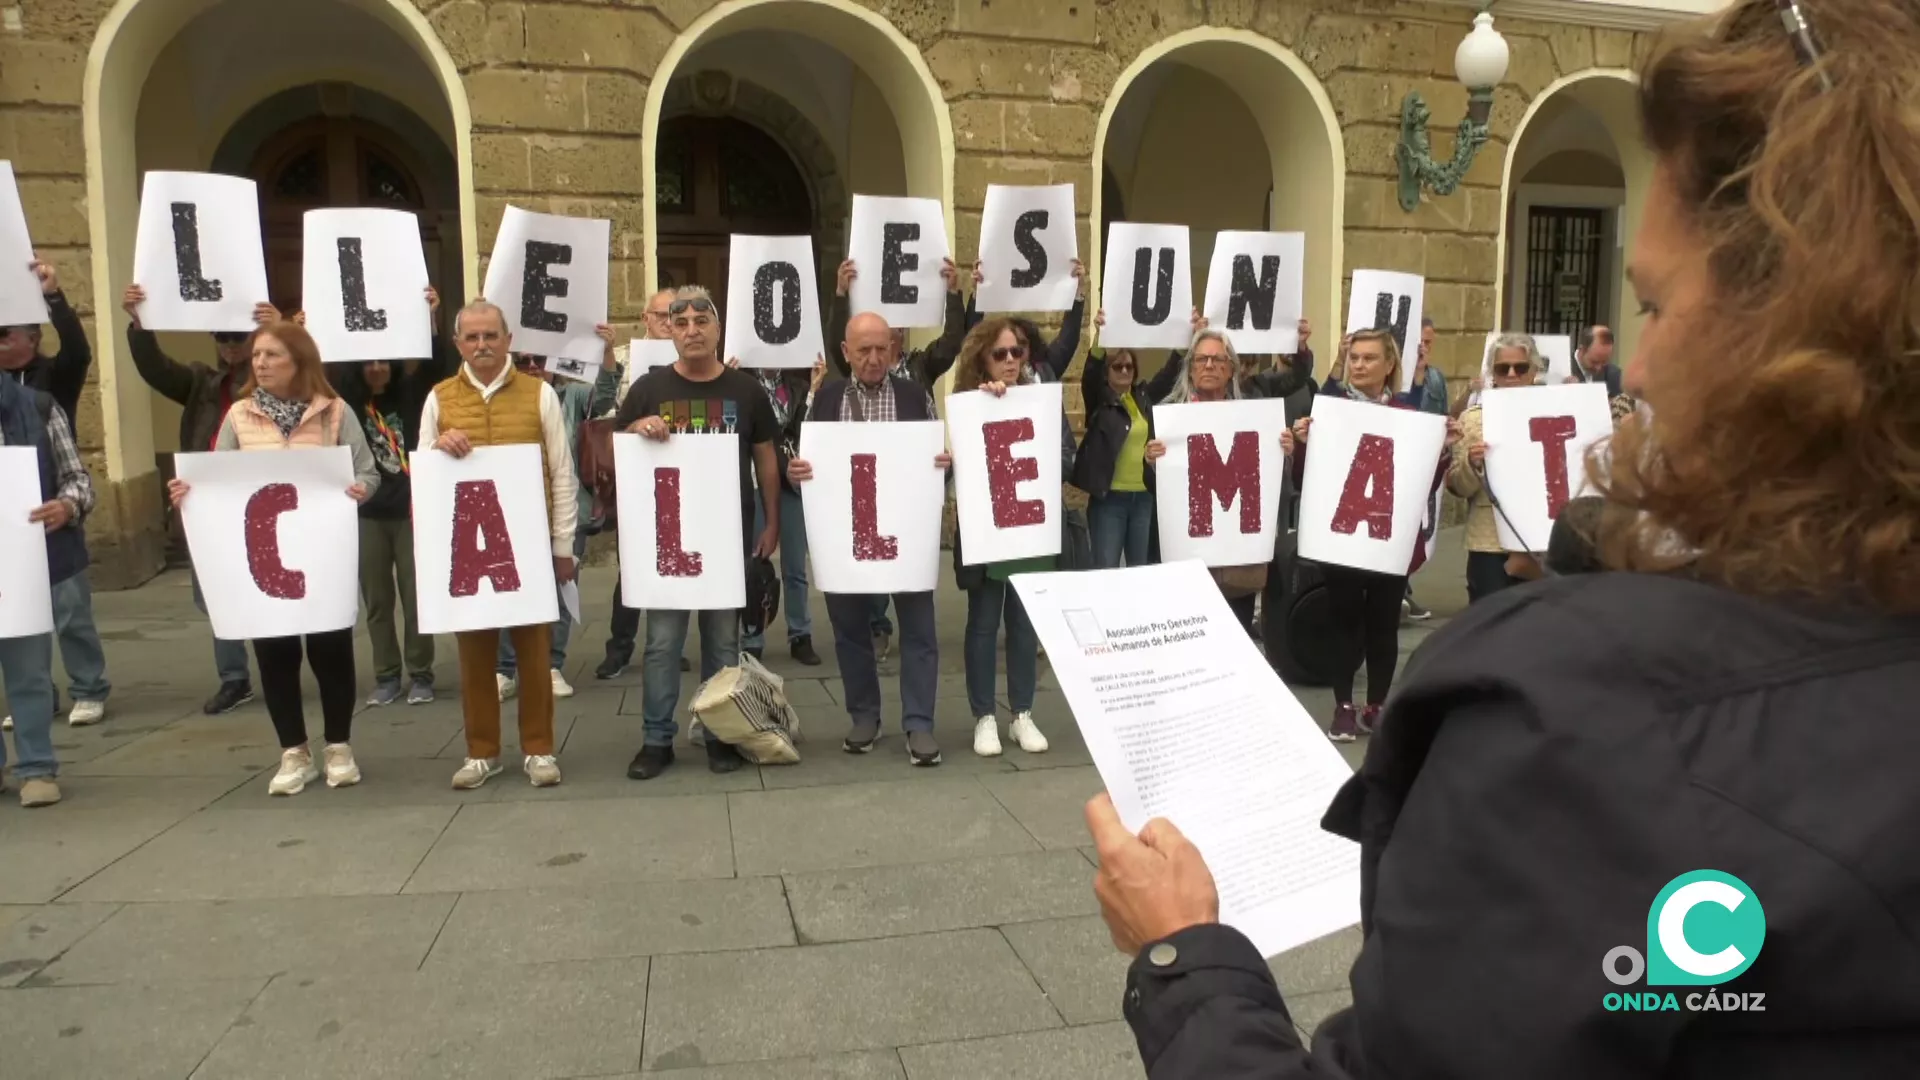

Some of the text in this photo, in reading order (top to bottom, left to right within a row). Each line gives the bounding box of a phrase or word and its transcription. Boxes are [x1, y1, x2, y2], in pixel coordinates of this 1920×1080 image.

[171, 203, 222, 302] L
[338, 237, 387, 332] L
[519, 240, 573, 334] E
[880, 222, 921, 305] E
[1011, 209, 1049, 289] S
[1131, 247, 1176, 326] U
[1226, 255, 1281, 331] N
[752, 261, 802, 345] O
[850, 453, 899, 562] L
[981, 417, 1046, 528] E
[1187, 431, 1262, 538] M
[1330, 433, 1395, 541] A
[1529, 415, 1577, 520] T
[244, 483, 306, 600] C
[448, 479, 521, 598] A
[653, 467, 703, 577] L
[1112, 639, 1151, 654] Humanos
[1151, 636, 1163, 647] de
[1151, 622, 1167, 633] Pro
[1167, 615, 1208, 629] Derechos
